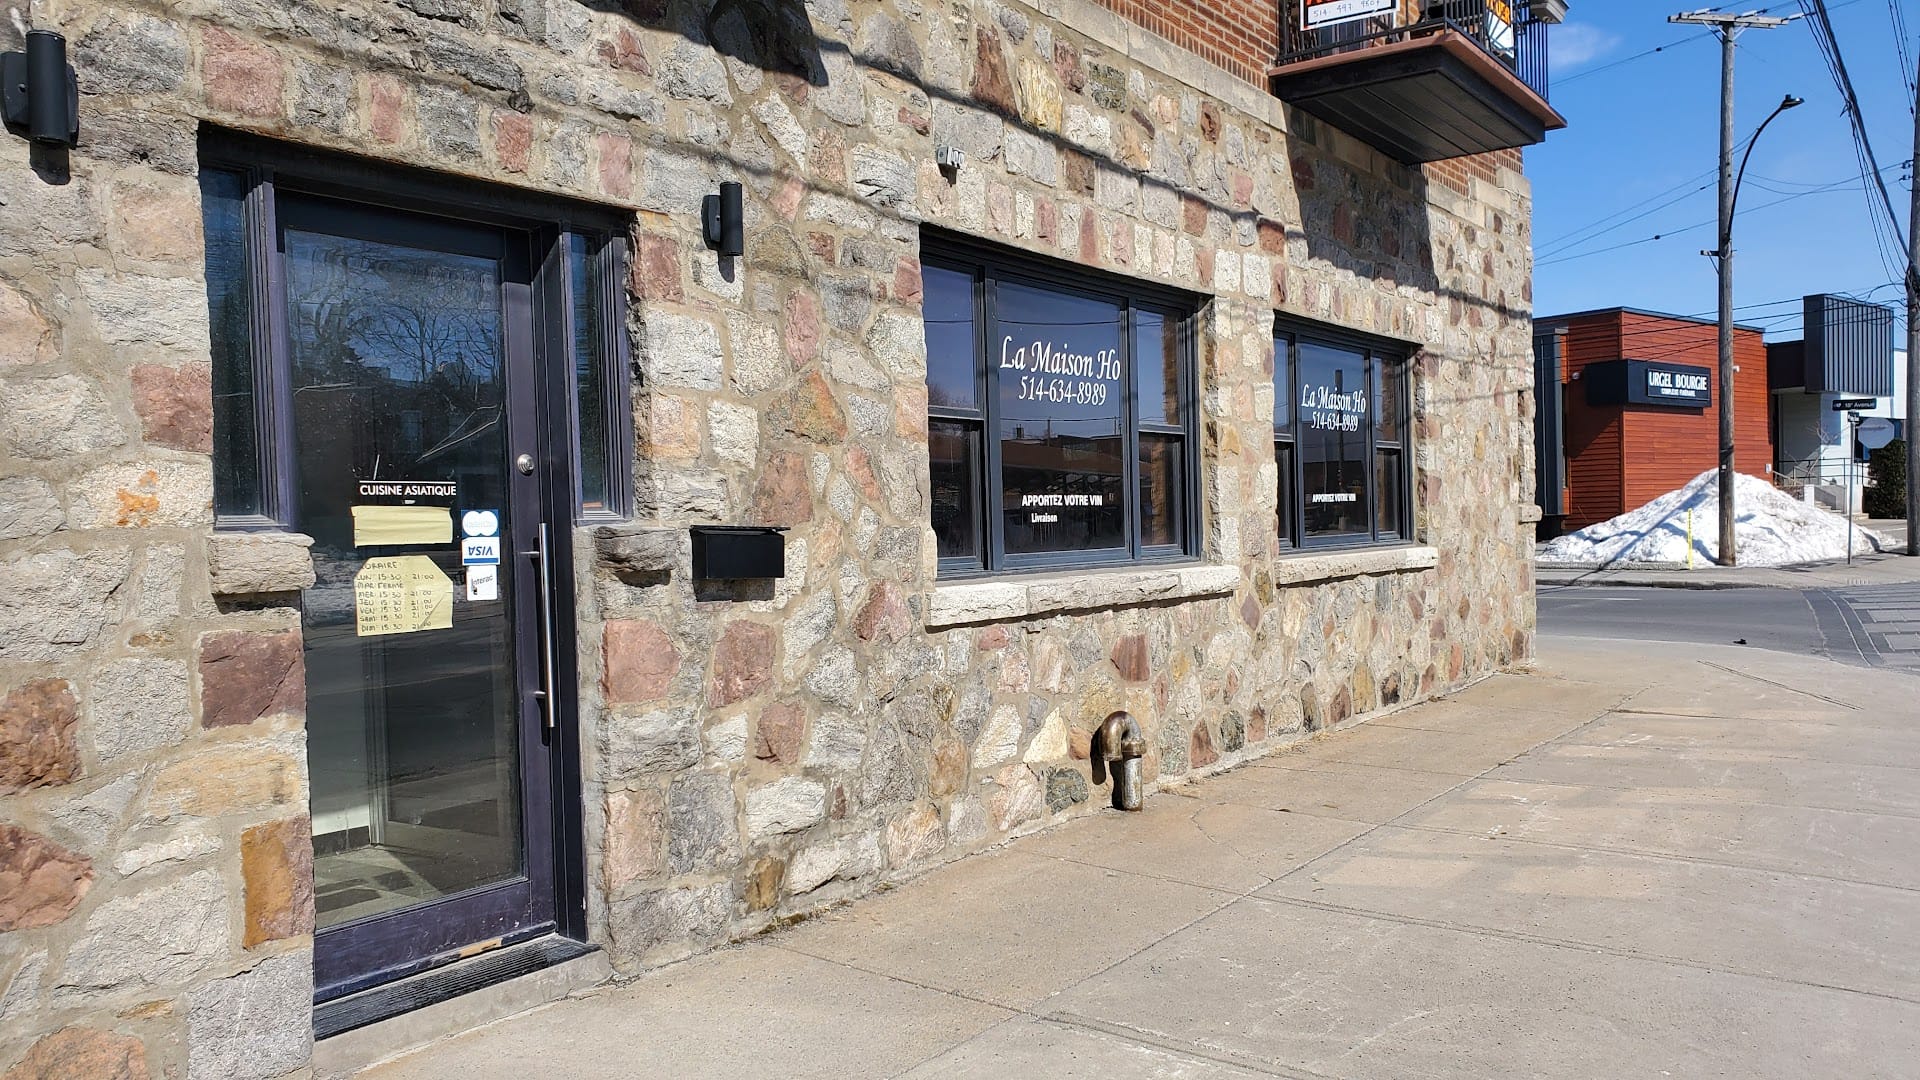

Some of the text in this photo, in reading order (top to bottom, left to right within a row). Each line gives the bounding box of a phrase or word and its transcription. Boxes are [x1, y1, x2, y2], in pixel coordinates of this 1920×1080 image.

[1000, 336, 1121, 381] La Maison Ho
[1649, 371, 1707, 390] URGEL BOURGIE
[1018, 376, 1107, 405] 514-634-8989
[1301, 383, 1367, 413] La Maison Ho
[1311, 411, 1359, 432] 514-634-8989
[359, 485, 457, 496] CUISINE ASIATIQUE
[1021, 495, 1102, 507] APPORTEZ VOTRE VIN
[1031, 512, 1058, 523] Livraison
[468, 545, 493, 556] VISA
[361, 561, 398, 570] ORAIRE
